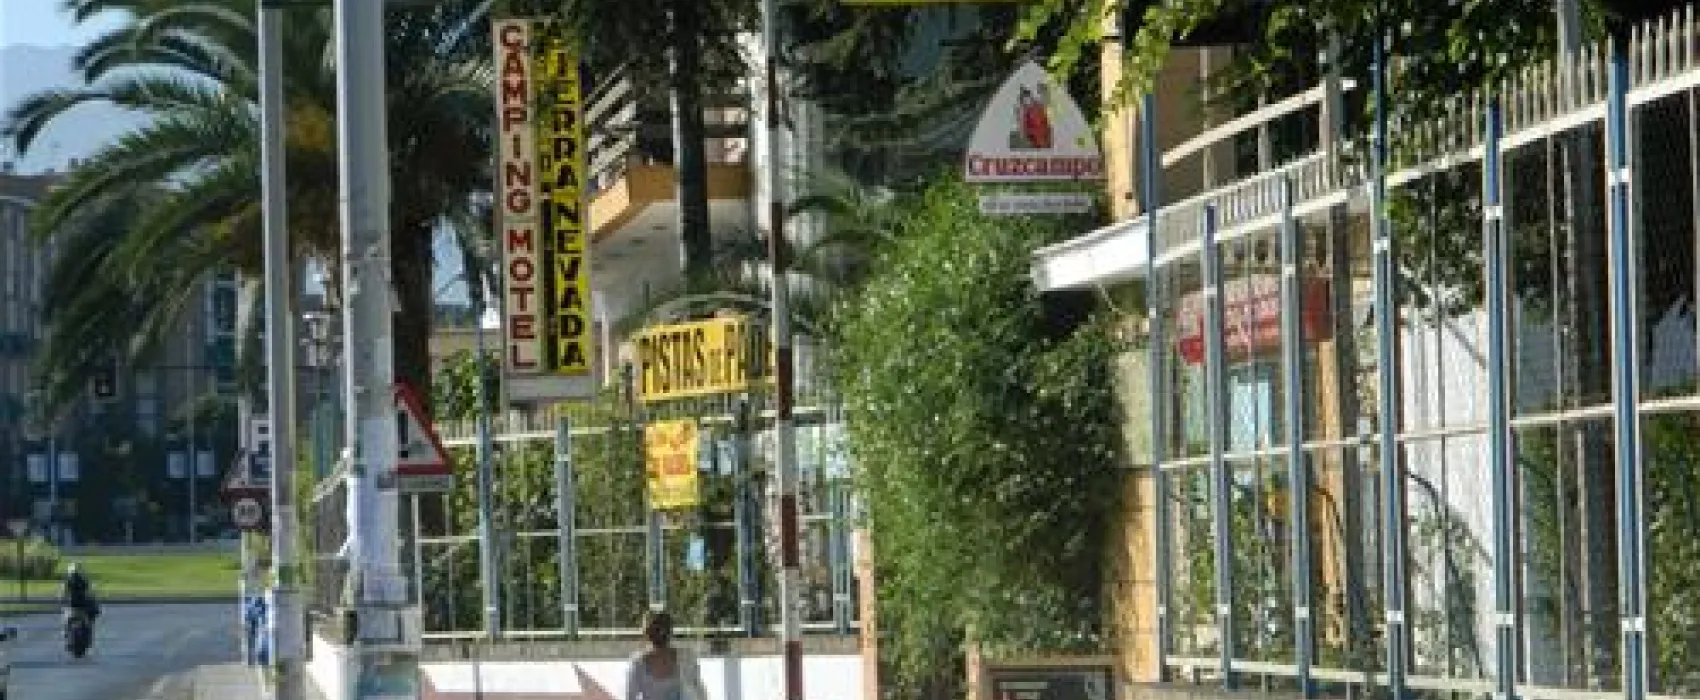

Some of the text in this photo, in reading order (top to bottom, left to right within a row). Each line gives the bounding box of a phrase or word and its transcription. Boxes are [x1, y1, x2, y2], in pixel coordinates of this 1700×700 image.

[502, 24, 538, 370] CAMPING MOTEL
[968, 154, 1101, 182] Cruzcampo
[556, 200, 586, 367] NEVADA
[639, 327, 705, 394] PISTAS
